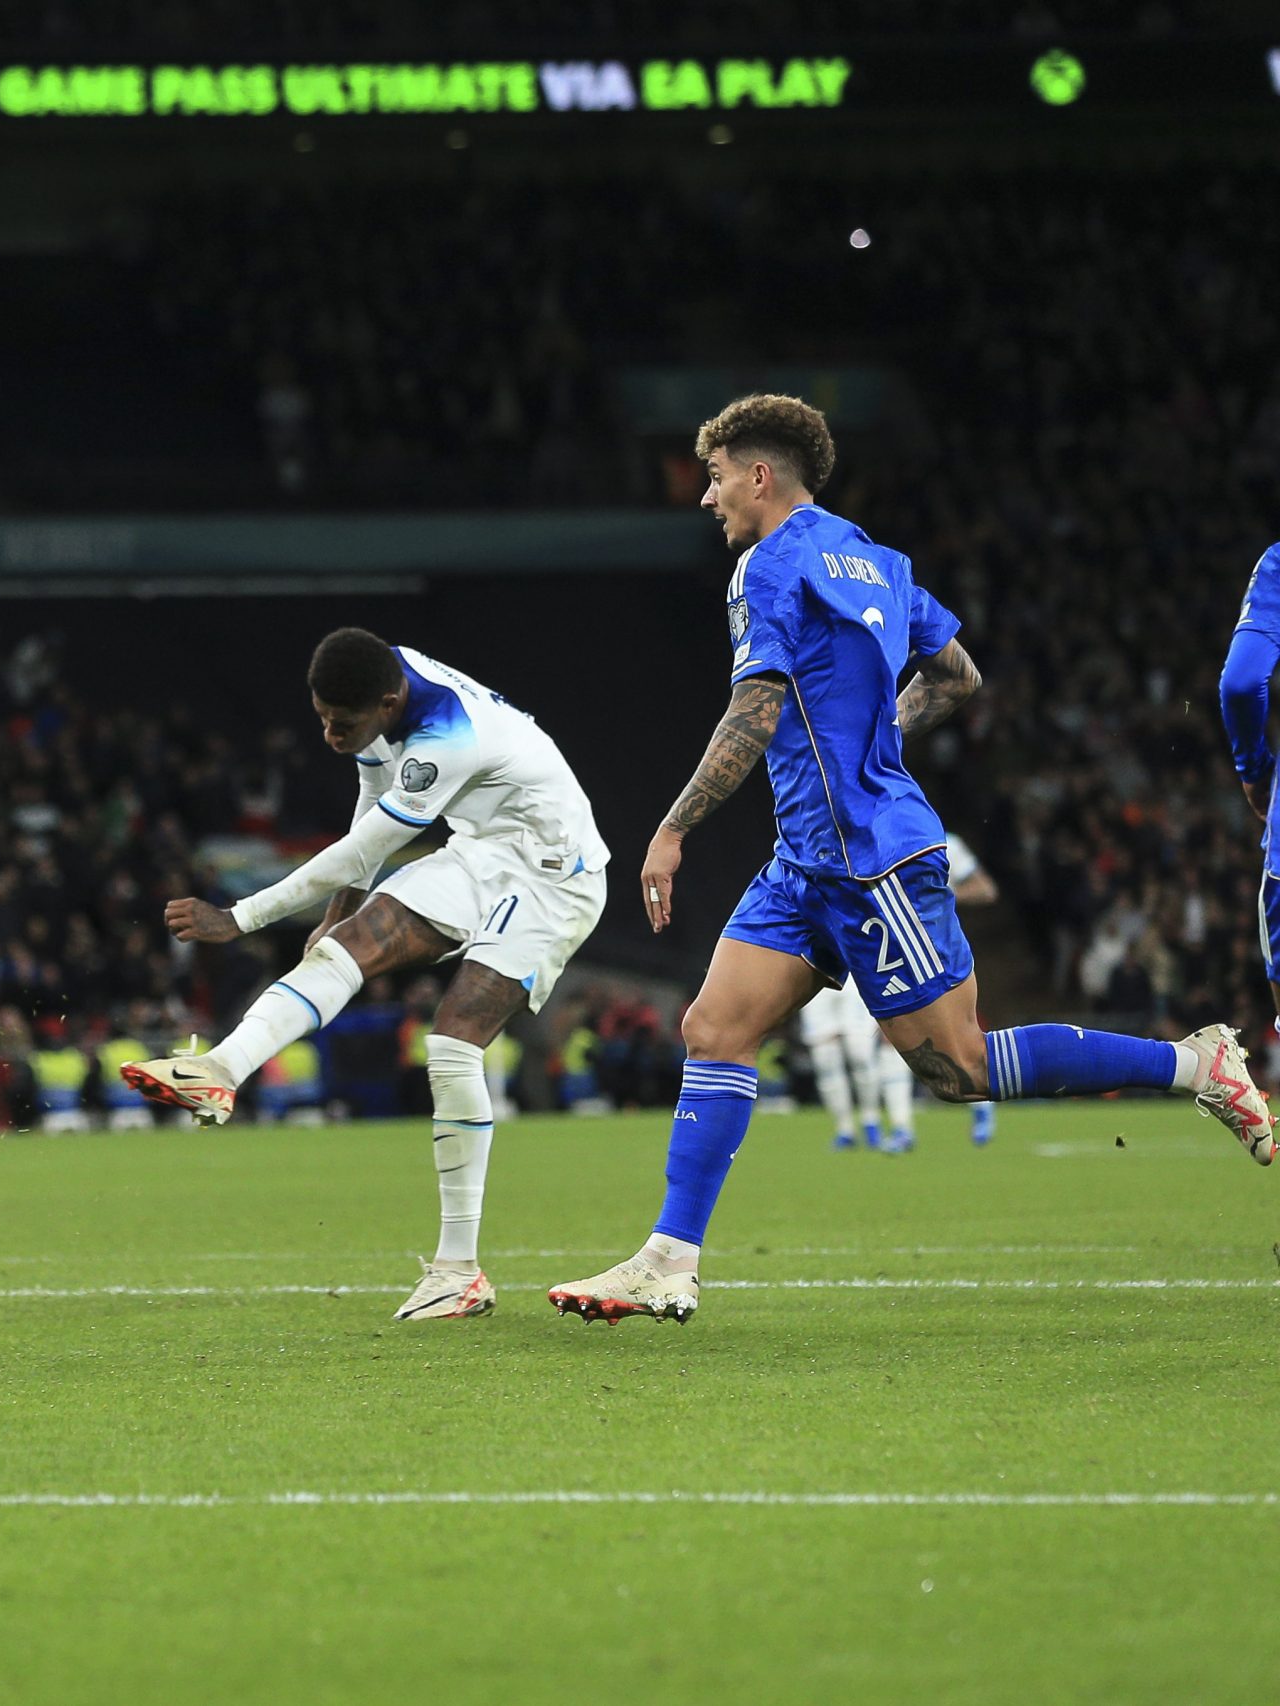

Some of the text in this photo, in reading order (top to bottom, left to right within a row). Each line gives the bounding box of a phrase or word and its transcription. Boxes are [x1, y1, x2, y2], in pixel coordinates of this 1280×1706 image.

[151, 65, 278, 114] PASS
[282, 63, 537, 113] ULTIMATE
[539, 62, 636, 110] VIA
[641, 61, 711, 109] EA
[717, 58, 850, 107] PLAY
[821, 552, 844, 579] DI
[861, 917, 905, 973] 2
[673, 1109, 698, 1122] LIA
